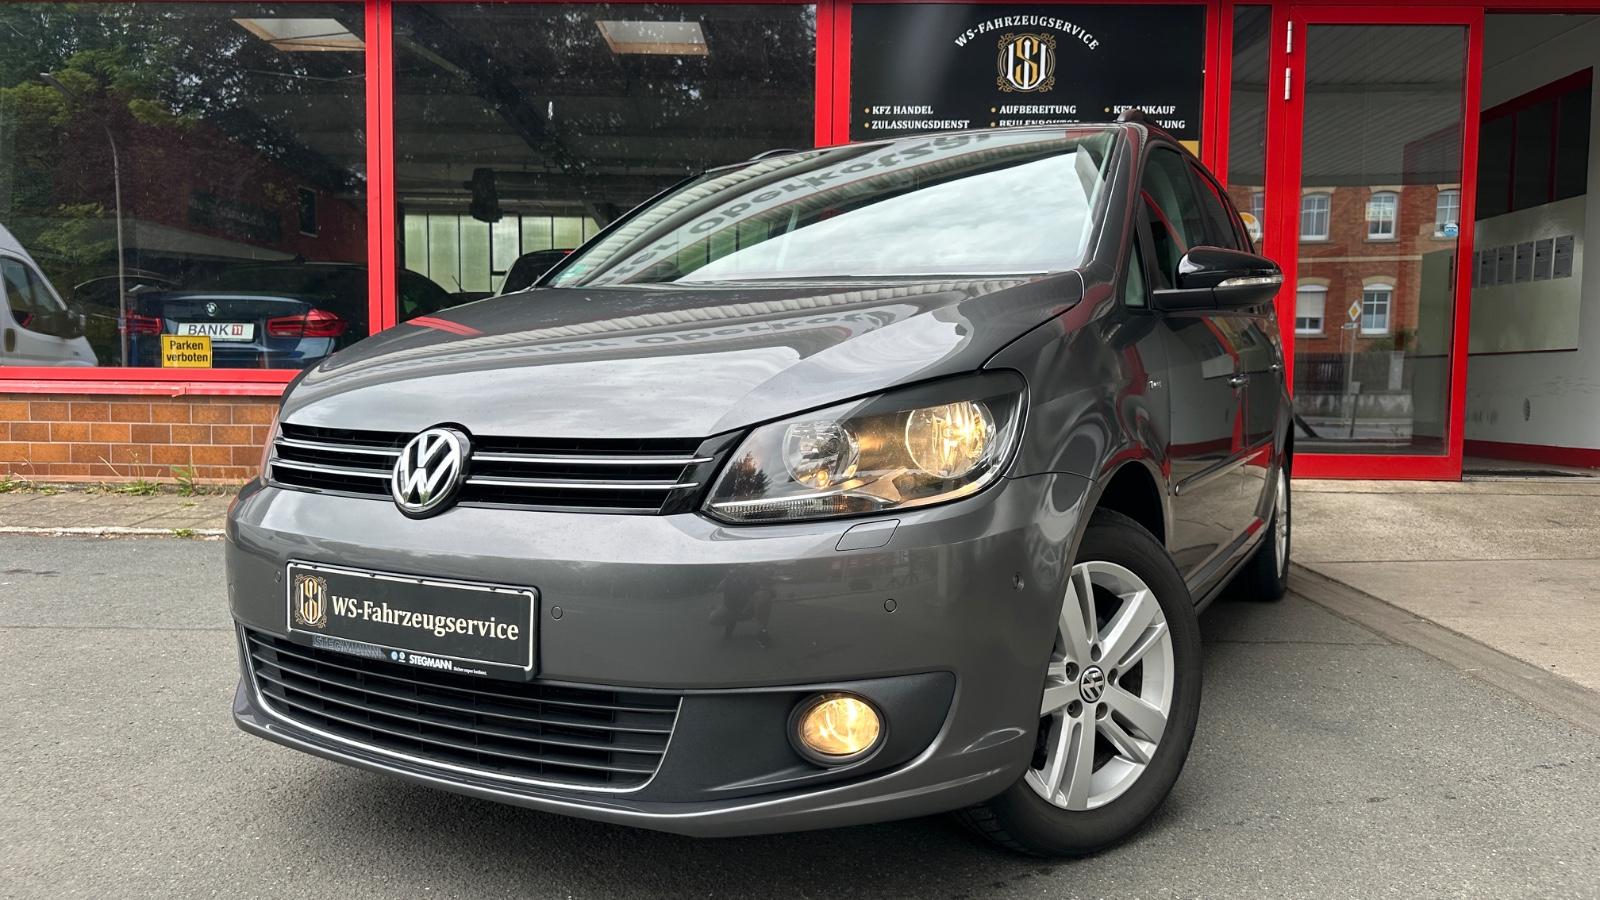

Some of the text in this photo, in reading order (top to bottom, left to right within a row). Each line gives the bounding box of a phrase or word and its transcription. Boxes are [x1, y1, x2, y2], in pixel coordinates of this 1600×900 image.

[955, 15, 1099, 50] WS-FAHRZEUGSERVICE
[872, 105, 933, 115] KFZ HANDEL
[1000, 105, 1076, 114] AUFBEREITUNG
[1136, 105, 1176, 114] NKAUF
[872, 120, 970, 129] ZULASSUNGSDIENST
[188, 324, 243, 336] BANK 11
[170, 340, 204, 350] Parken
[166, 352, 208, 362] verboten
[332, 595, 519, 640] WS-Fahrzeugservice
[409, 654, 452, 670] STEGMANN
